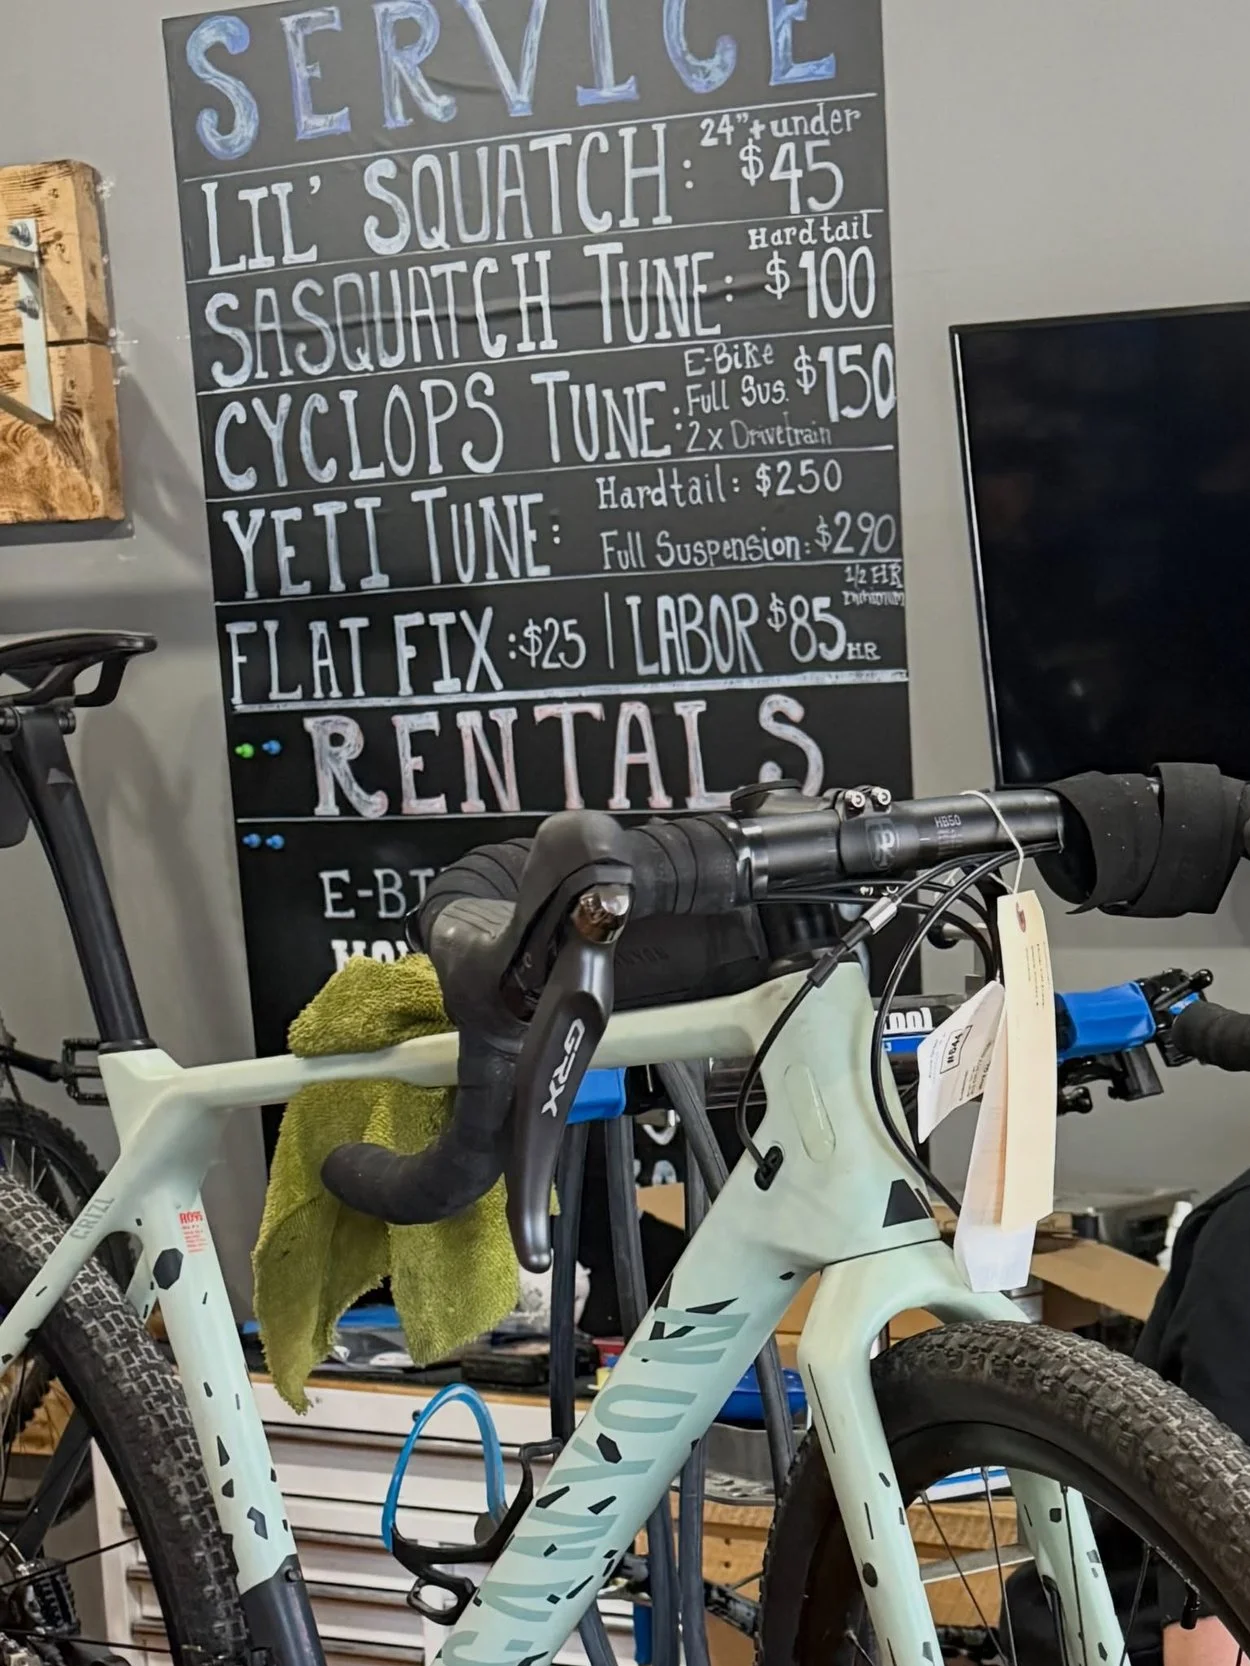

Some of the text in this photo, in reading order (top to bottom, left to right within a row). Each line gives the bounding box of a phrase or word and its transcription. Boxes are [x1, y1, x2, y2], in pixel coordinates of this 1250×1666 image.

[187, 0, 836, 160] SERVICE
[769, 102, 862, 138] under
[201, 123, 844, 277] LIL' SQUATCH: $45
[748, 213, 873, 251] Hardtail
[205, 241, 877, 389] SASQUATCH TUNE: $100
[215, 342, 897, 492] CYCLOPS TUNE: $150
[686, 375, 790, 416] Full Sus.
[731, 411, 832, 450] Drivetrain
[596, 459, 843, 509] Hardtail: $250
[222, 486, 562, 600] YETI TUNE:
[600, 511, 898, 571] Full Suspension: $290
[226, 617, 370, 702] FLAT
[625, 592, 765, 676] LABOR
[767, 592, 847, 664] $85
[847, 642, 882, 662] HR
[304, 694, 827, 817] RENTALS
[318, 867, 437, 919] E-BI
[540, 1018, 586, 1118] GRX
